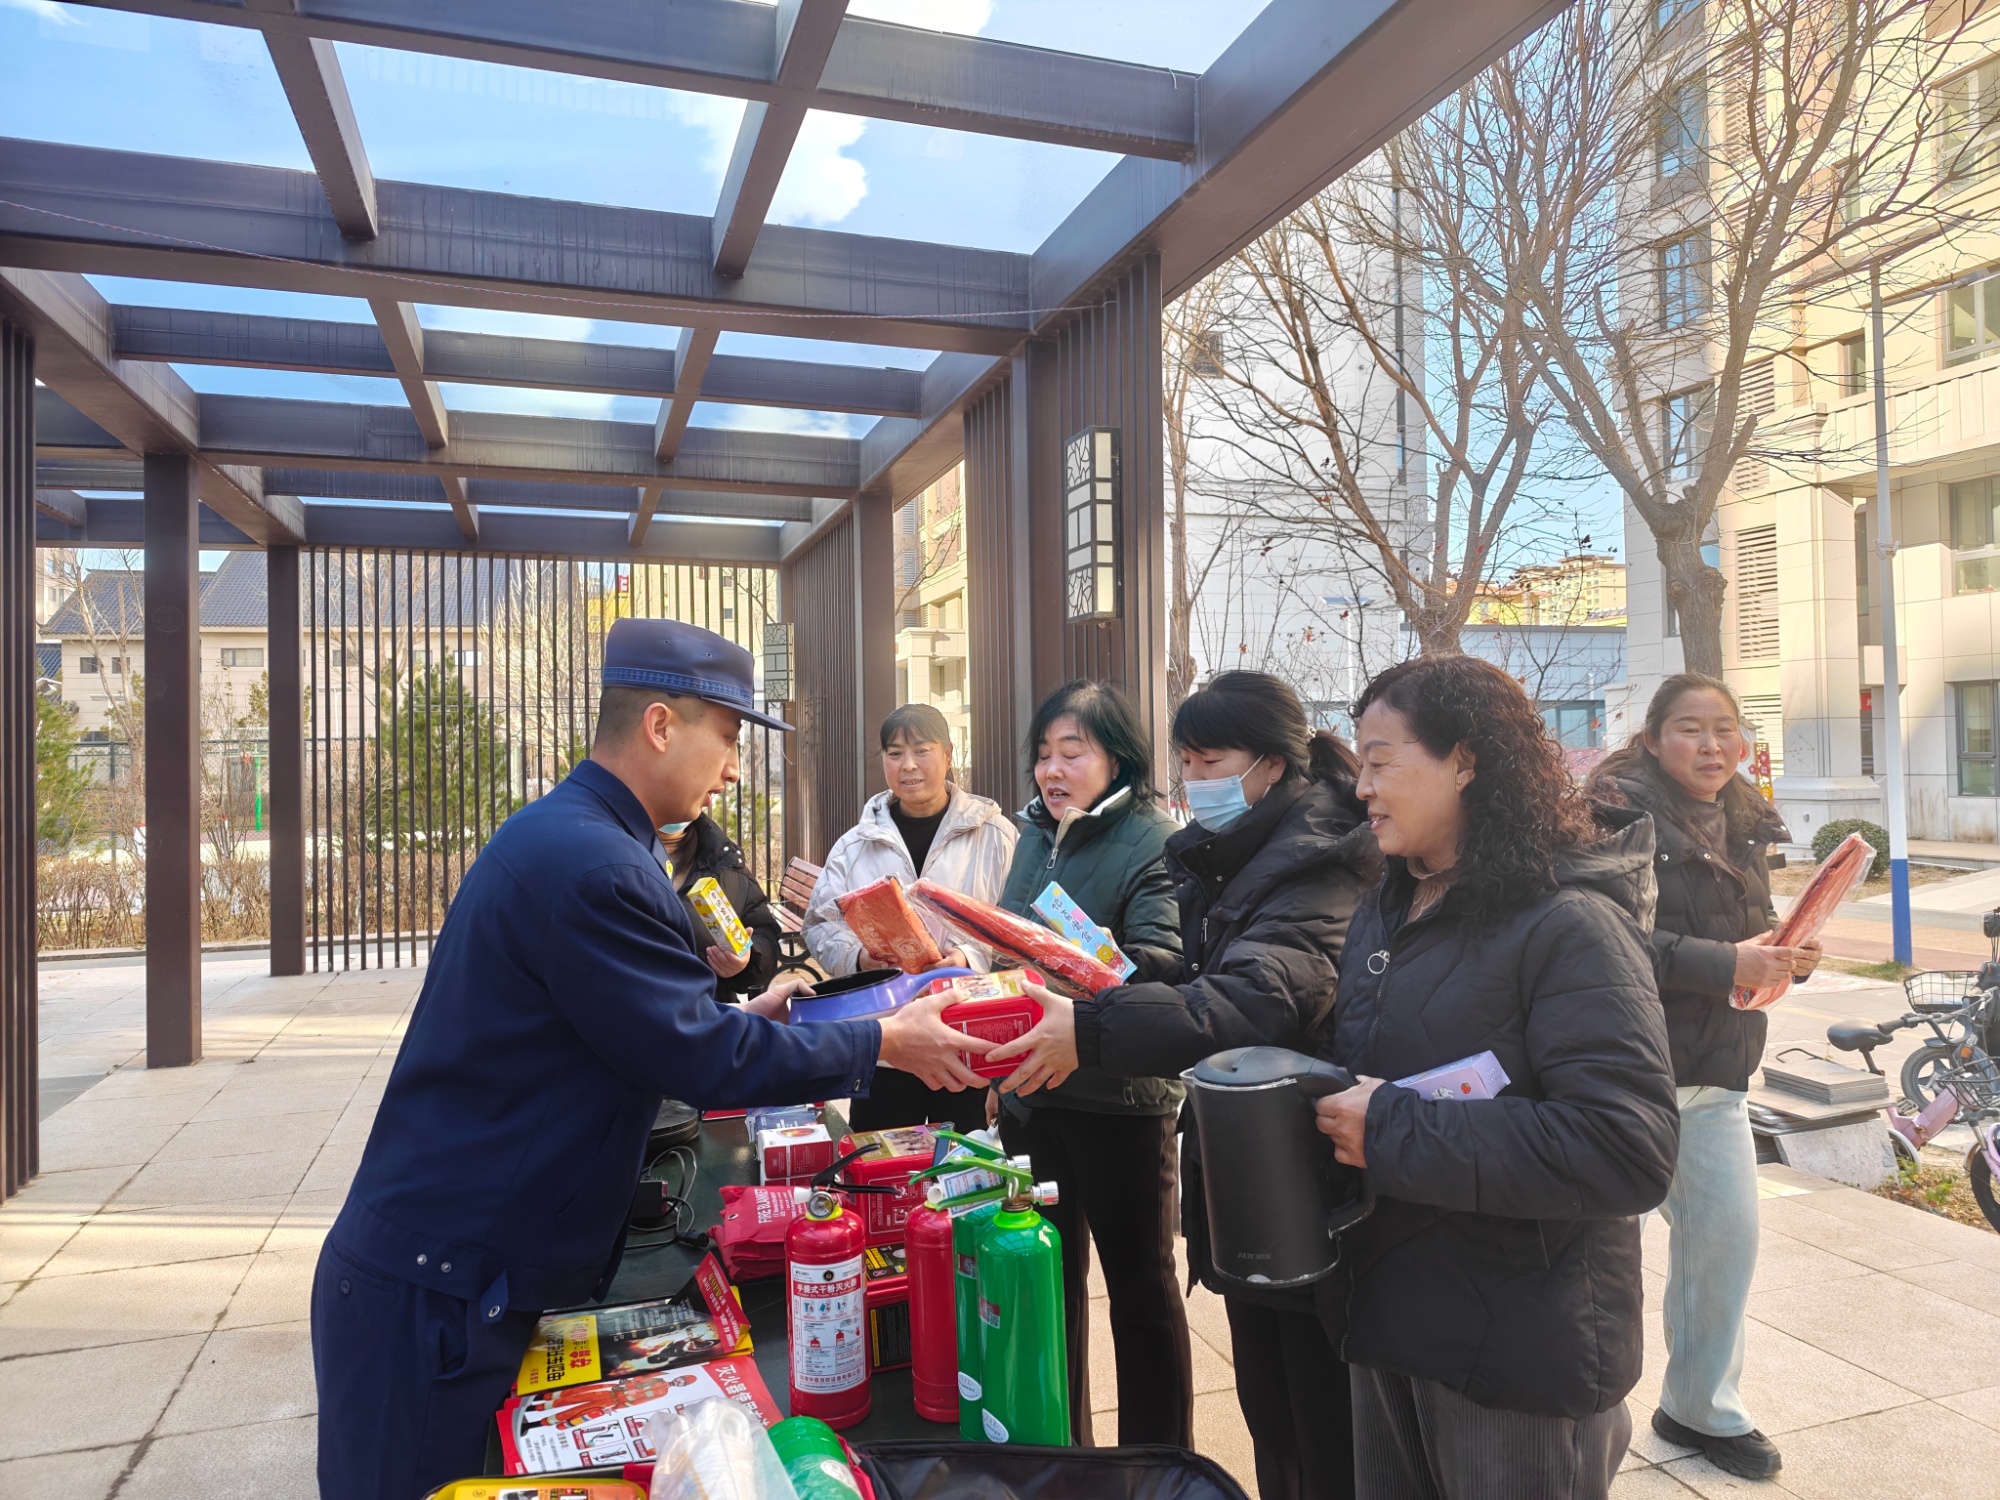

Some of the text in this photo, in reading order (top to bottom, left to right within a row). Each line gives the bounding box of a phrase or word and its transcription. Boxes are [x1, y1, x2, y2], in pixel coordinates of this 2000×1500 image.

[757, 1209, 772, 1224] FIRE
[797, 1278, 857, 1294] 手提式干粉灭火器
